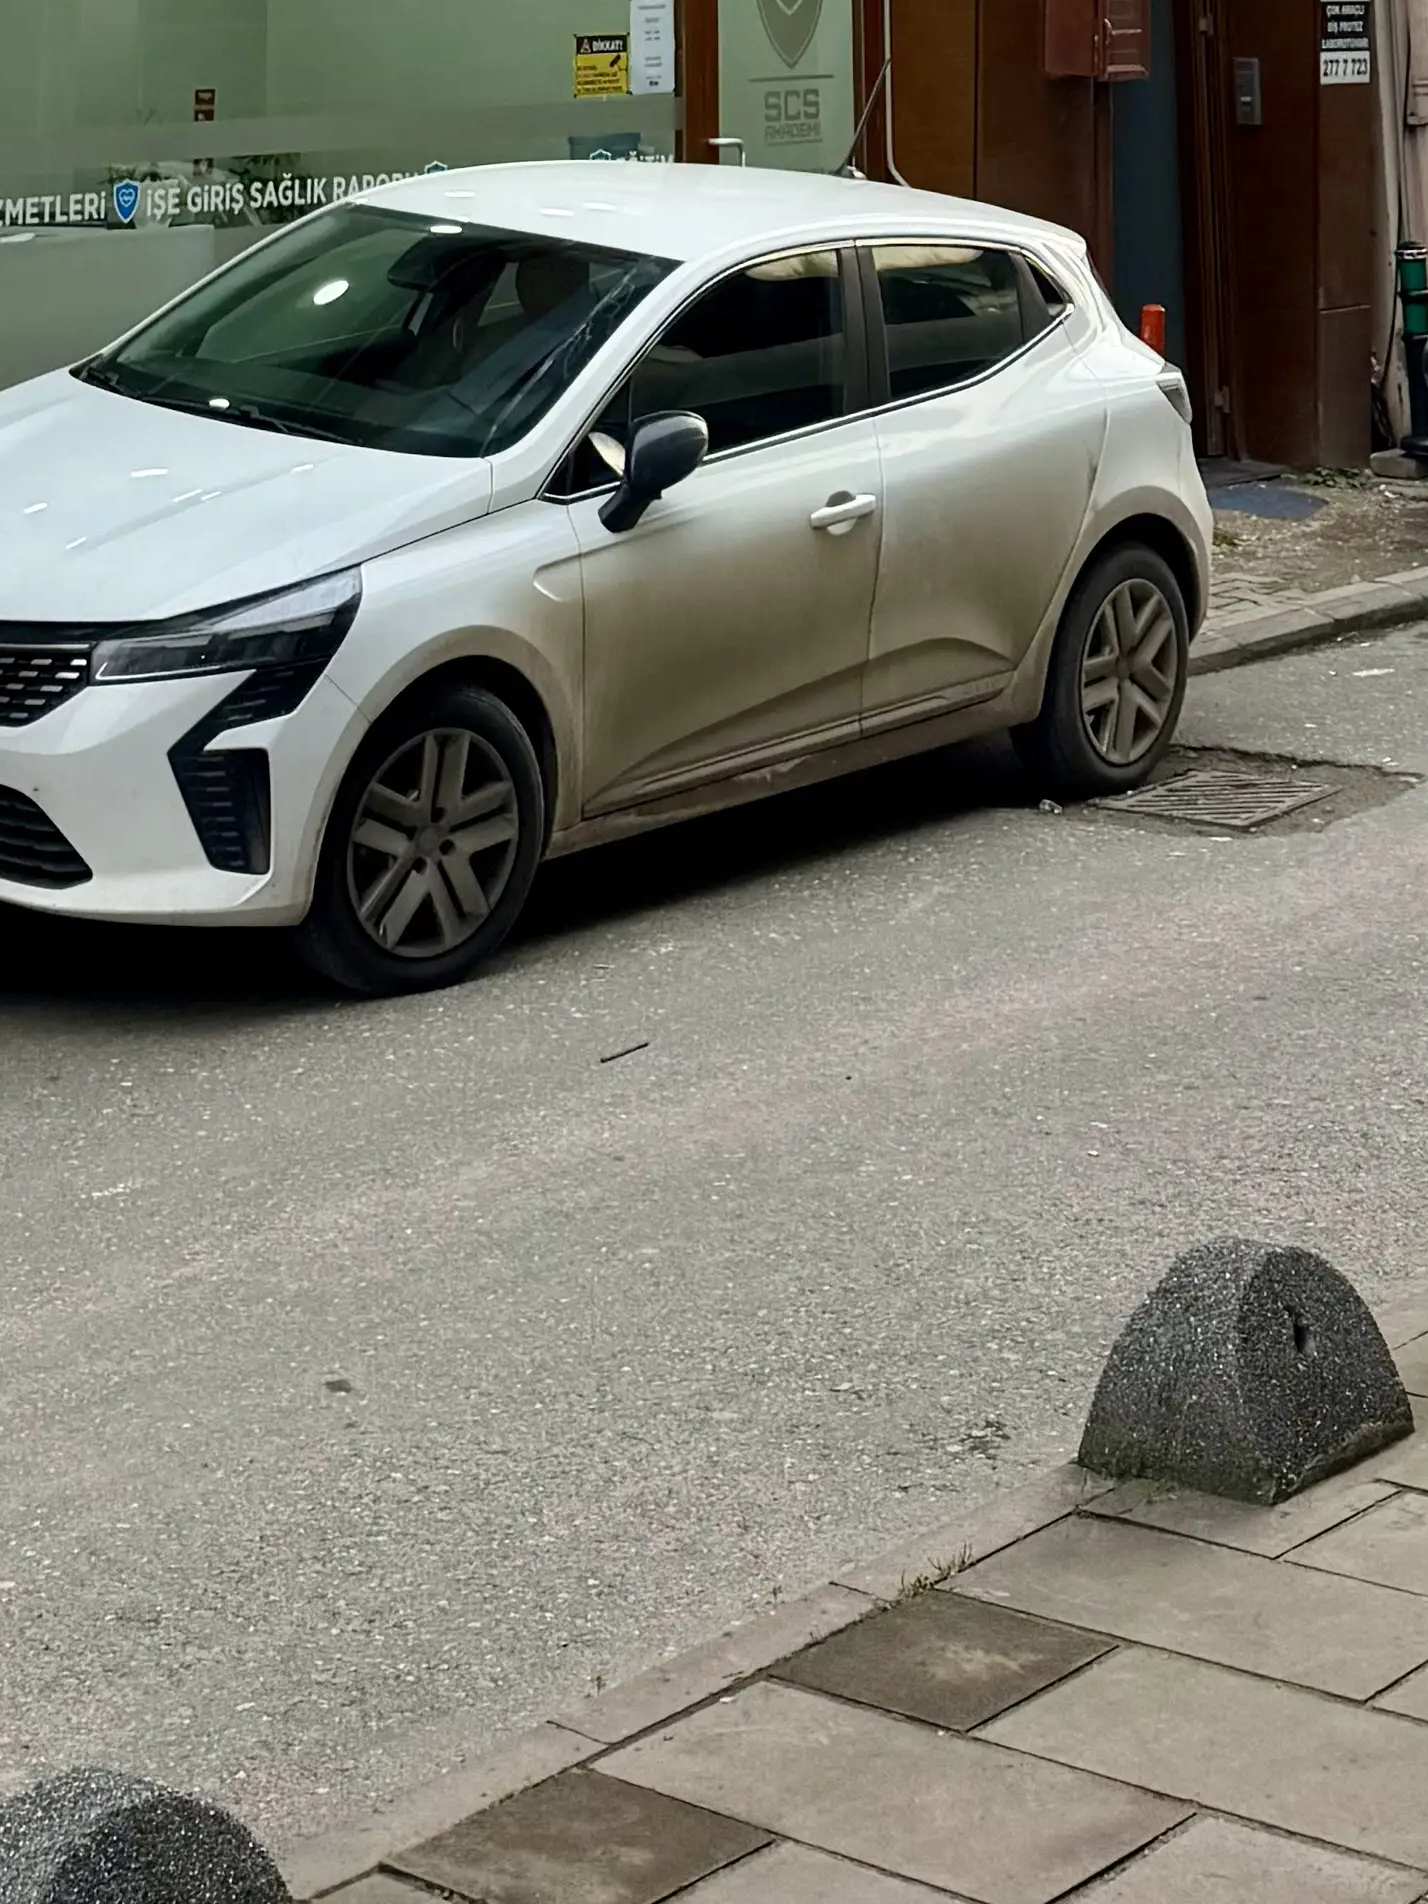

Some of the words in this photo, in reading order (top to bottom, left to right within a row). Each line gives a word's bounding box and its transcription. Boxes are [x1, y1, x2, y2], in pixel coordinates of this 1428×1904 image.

[1323, 59, 1340, 77] 277
[1351, 58, 1368, 76] 723
[764, 88, 820, 122] SCS
[249, 173, 327, 209] SAĞLIK
